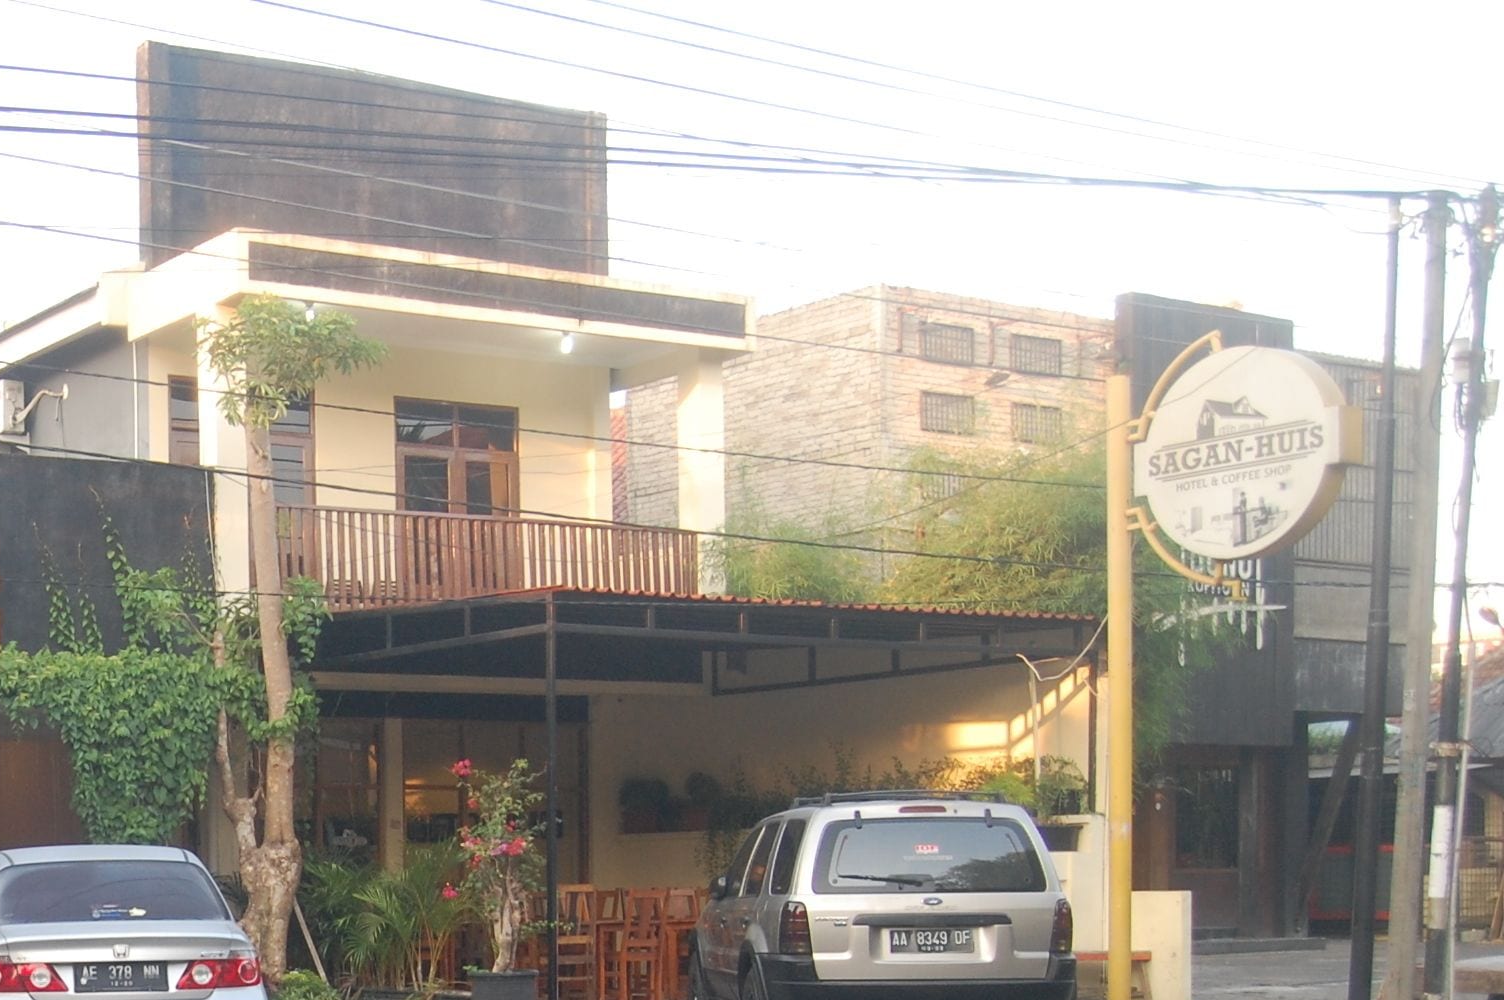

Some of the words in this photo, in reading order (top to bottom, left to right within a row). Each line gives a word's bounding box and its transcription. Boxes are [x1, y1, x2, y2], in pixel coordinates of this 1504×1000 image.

[1148, 425, 1324, 477] SAGAN-HUIS
[1176, 479, 1208, 493] HOTEL
[1211, 476, 1219, 487] &
[1222, 469, 1261, 485] COFFEE
[1264, 464, 1292, 479] SHOP
[892, 931, 908, 946] AA
[917, 931, 948, 945] 8349
[81, 965, 98, 980] AE
[108, 965, 133, 980] 378
[143, 964, 160, 980] NN
